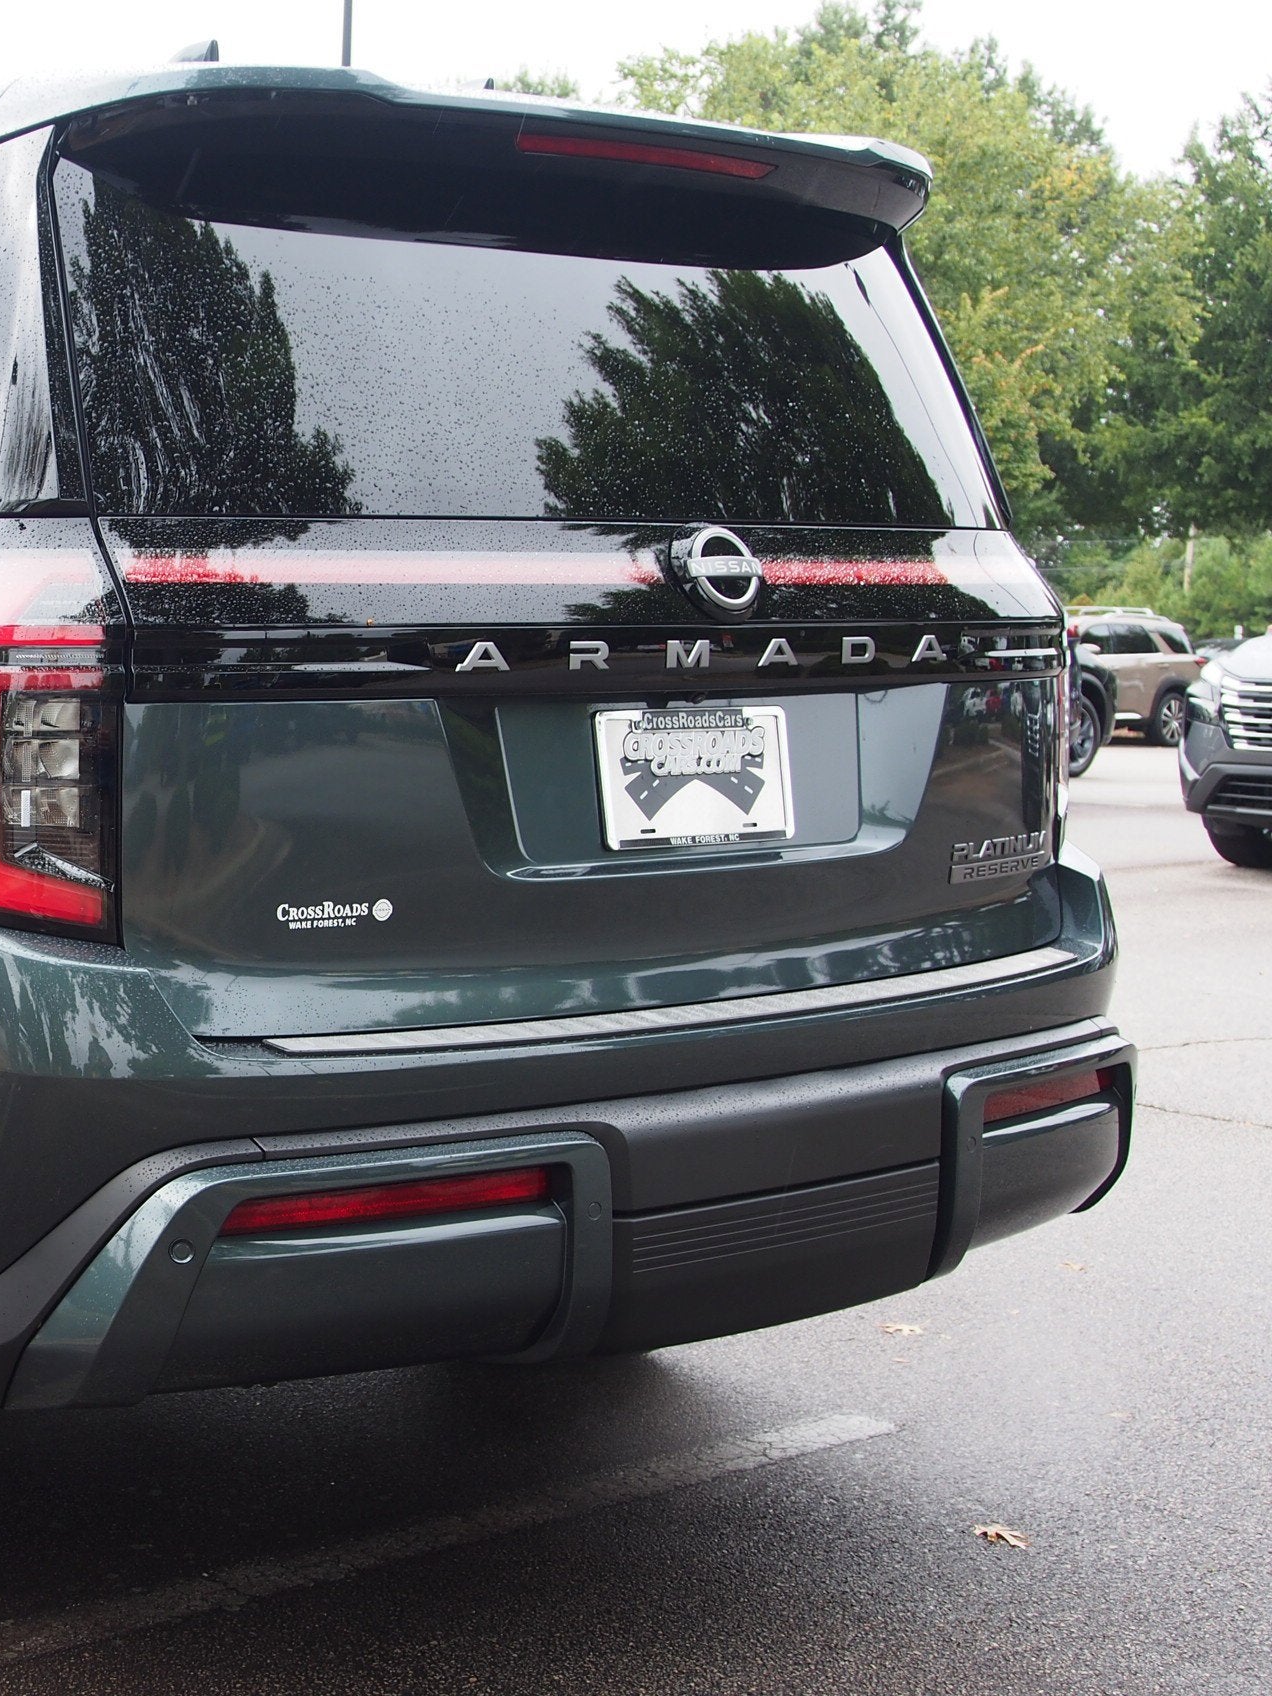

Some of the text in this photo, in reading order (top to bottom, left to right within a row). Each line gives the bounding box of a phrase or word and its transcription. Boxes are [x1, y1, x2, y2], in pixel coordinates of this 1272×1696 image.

[690, 561, 762, 574] NISSAN
[455, 634, 947, 672] ARMADA
[643, 711, 743, 729] CrossRoadsCars
[623, 726, 765, 761] CROSSROADS
[670, 836, 693, 845] WAKE
[729, 833, 740, 842] NC
[963, 856, 1039, 880] RESERVE
[289, 917, 357, 929] WAKE FOREST, NC
